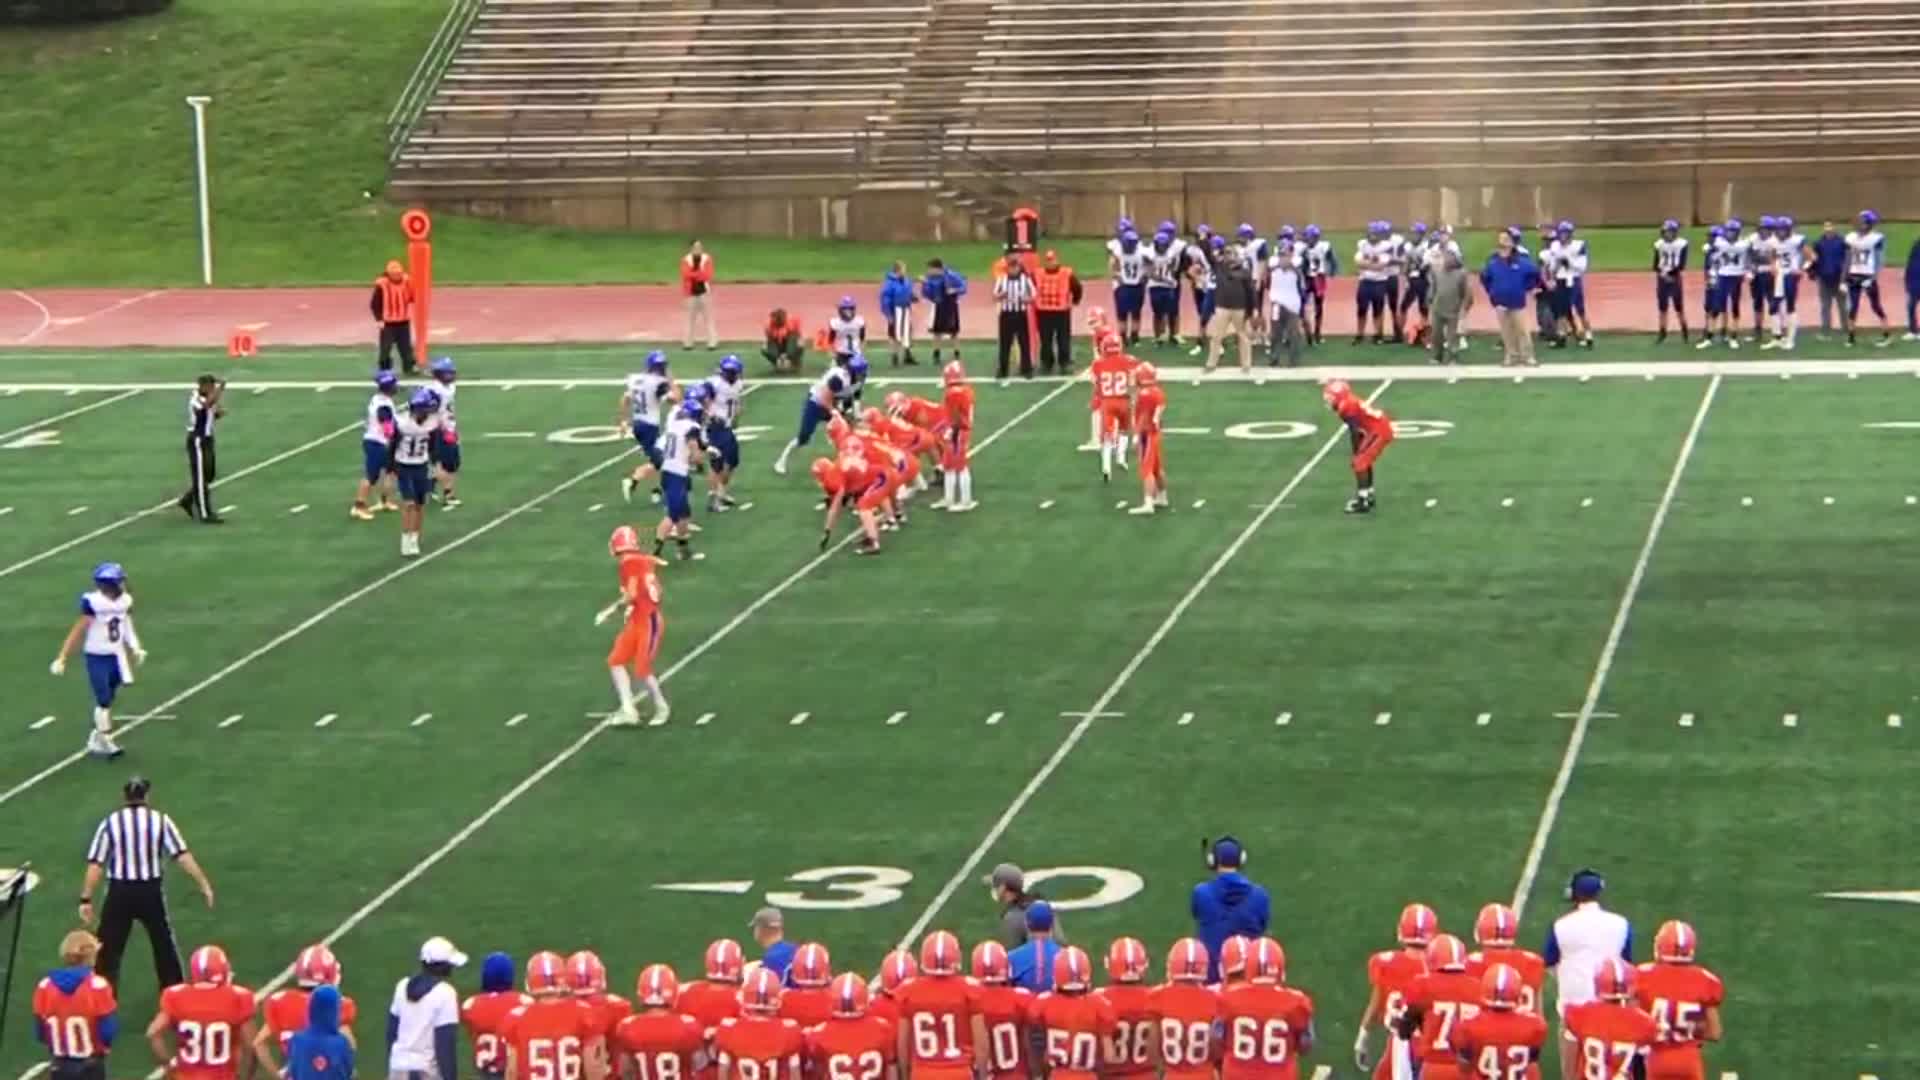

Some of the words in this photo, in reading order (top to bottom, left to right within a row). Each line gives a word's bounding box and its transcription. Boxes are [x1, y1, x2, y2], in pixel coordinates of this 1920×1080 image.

[1099, 372, 1128, 398] 22
[108, 615, 121, 643] 8
[45, 1016, 94, 1058] 10
[912, 1011, 963, 1059] 61
[1161, 1017, 1210, 1065] 88
[1232, 1016, 1289, 1063] 66
[1650, 997, 1703, 1042] 45
[177, 1020, 232, 1066] 30
[528, 1036, 581, 1080] 56
[1047, 1029, 1097, 1071] 50
[1477, 1045, 1530, 1080] 42
[1582, 1037, 1637, 1080] 87
